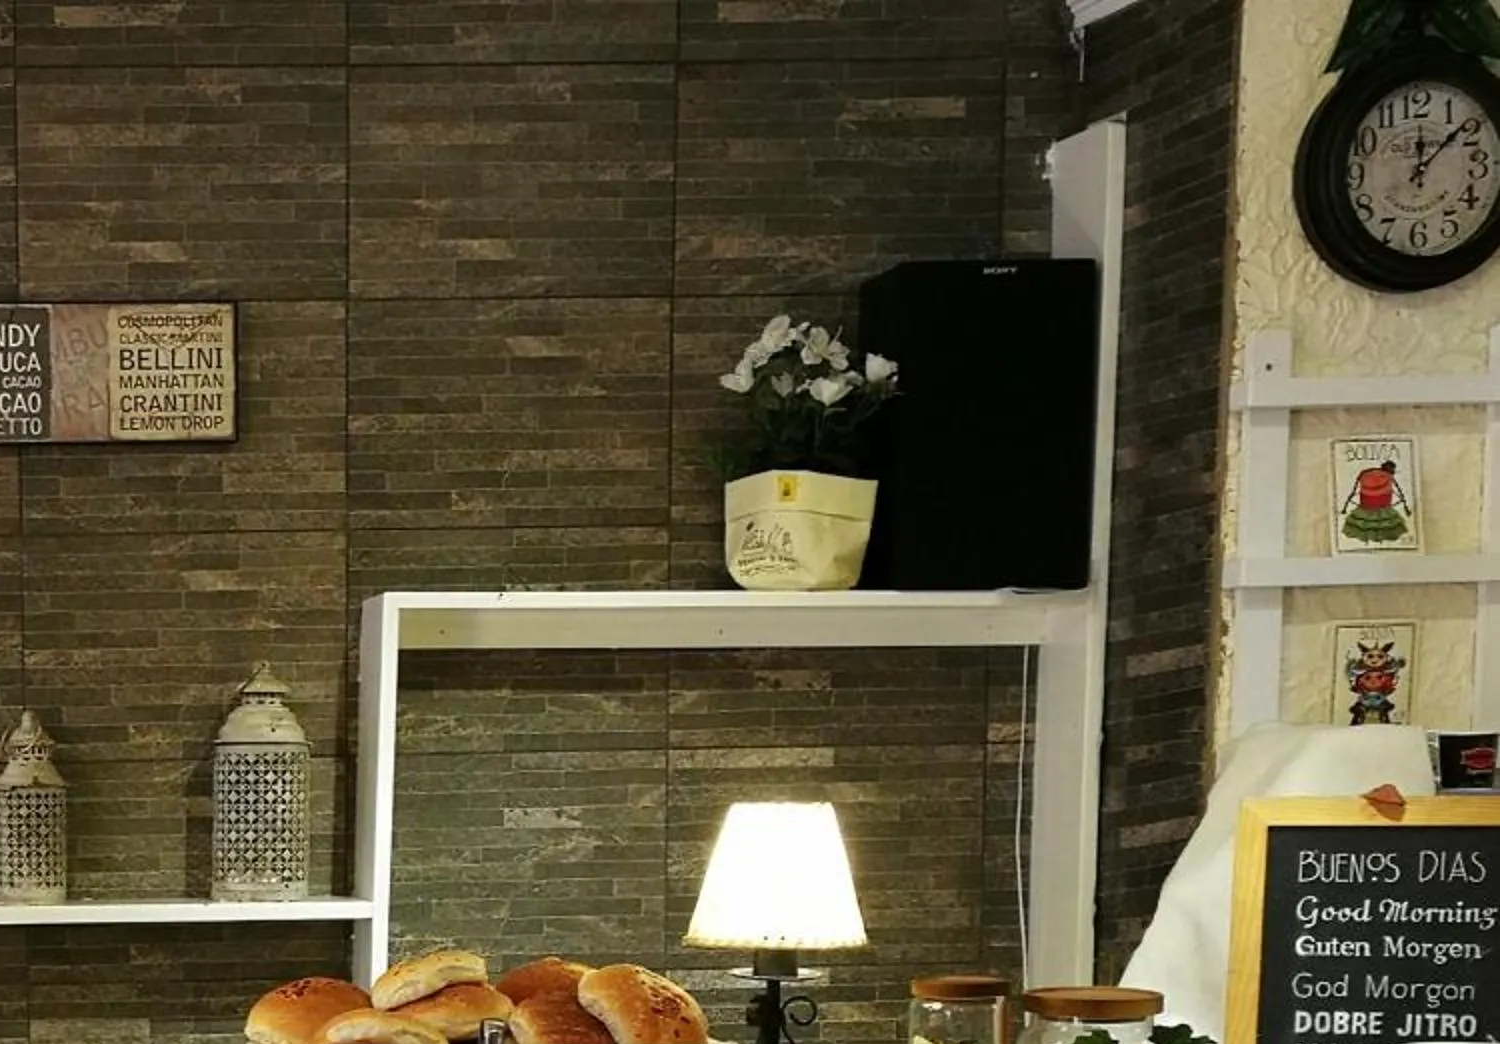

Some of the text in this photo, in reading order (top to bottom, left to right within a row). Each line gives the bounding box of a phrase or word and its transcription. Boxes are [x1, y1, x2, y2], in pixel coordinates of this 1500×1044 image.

[1378, 102, 1395, 128] 11
[1402, 90, 1431, 119] 12
[1444, 98, 1454, 124] 1
[1461, 118, 1481, 147] 2
[1348, 163, 1365, 190] 9
[1467, 150, 1489, 179] 3
[1355, 193, 1373, 221] 8
[1458, 184, 1479, 210] 4
[1379, 217, 1396, 244] 7
[1409, 221, 1428, 248] 6
[1440, 209, 1459, 239] 5
[119, 348, 223, 371] BELLINI
[3, 377, 42, 389] CACAO
[119, 374, 224, 389] MANHATTAN
[120, 394, 223, 412] CRANTINI
[120, 416, 225, 431] LEMON DROP
[1297, 850, 1487, 883] BUENOS DIAS
[1295, 896, 1498, 930] Good Morning
[1294, 935, 1482, 964] Guten Morgen
[1291, 973, 1475, 1008] God Morgon
[1294, 1010, 1477, 1037] DOBRE JITRO
